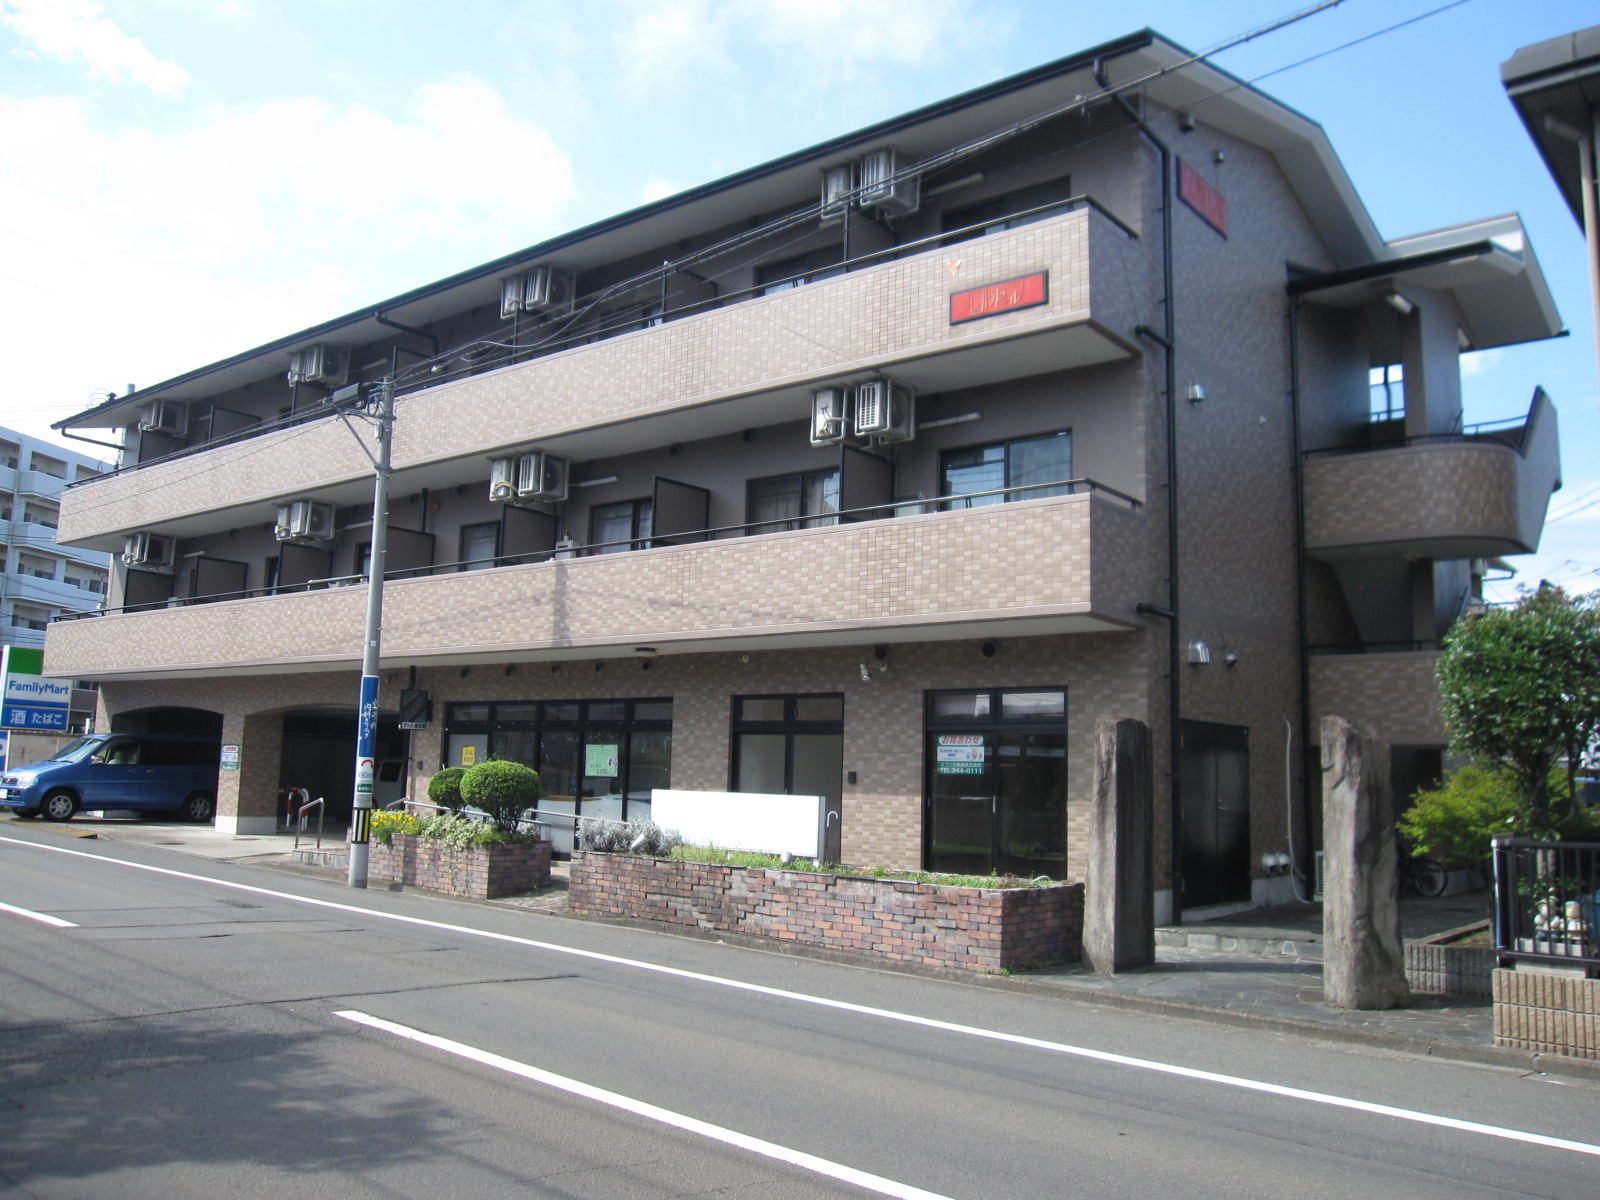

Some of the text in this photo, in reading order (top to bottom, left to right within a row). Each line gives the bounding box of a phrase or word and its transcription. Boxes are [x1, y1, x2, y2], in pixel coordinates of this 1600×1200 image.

[9, 681, 69, 694] FamilyMart
[10, 710, 62, 724] 酒 たばこ
